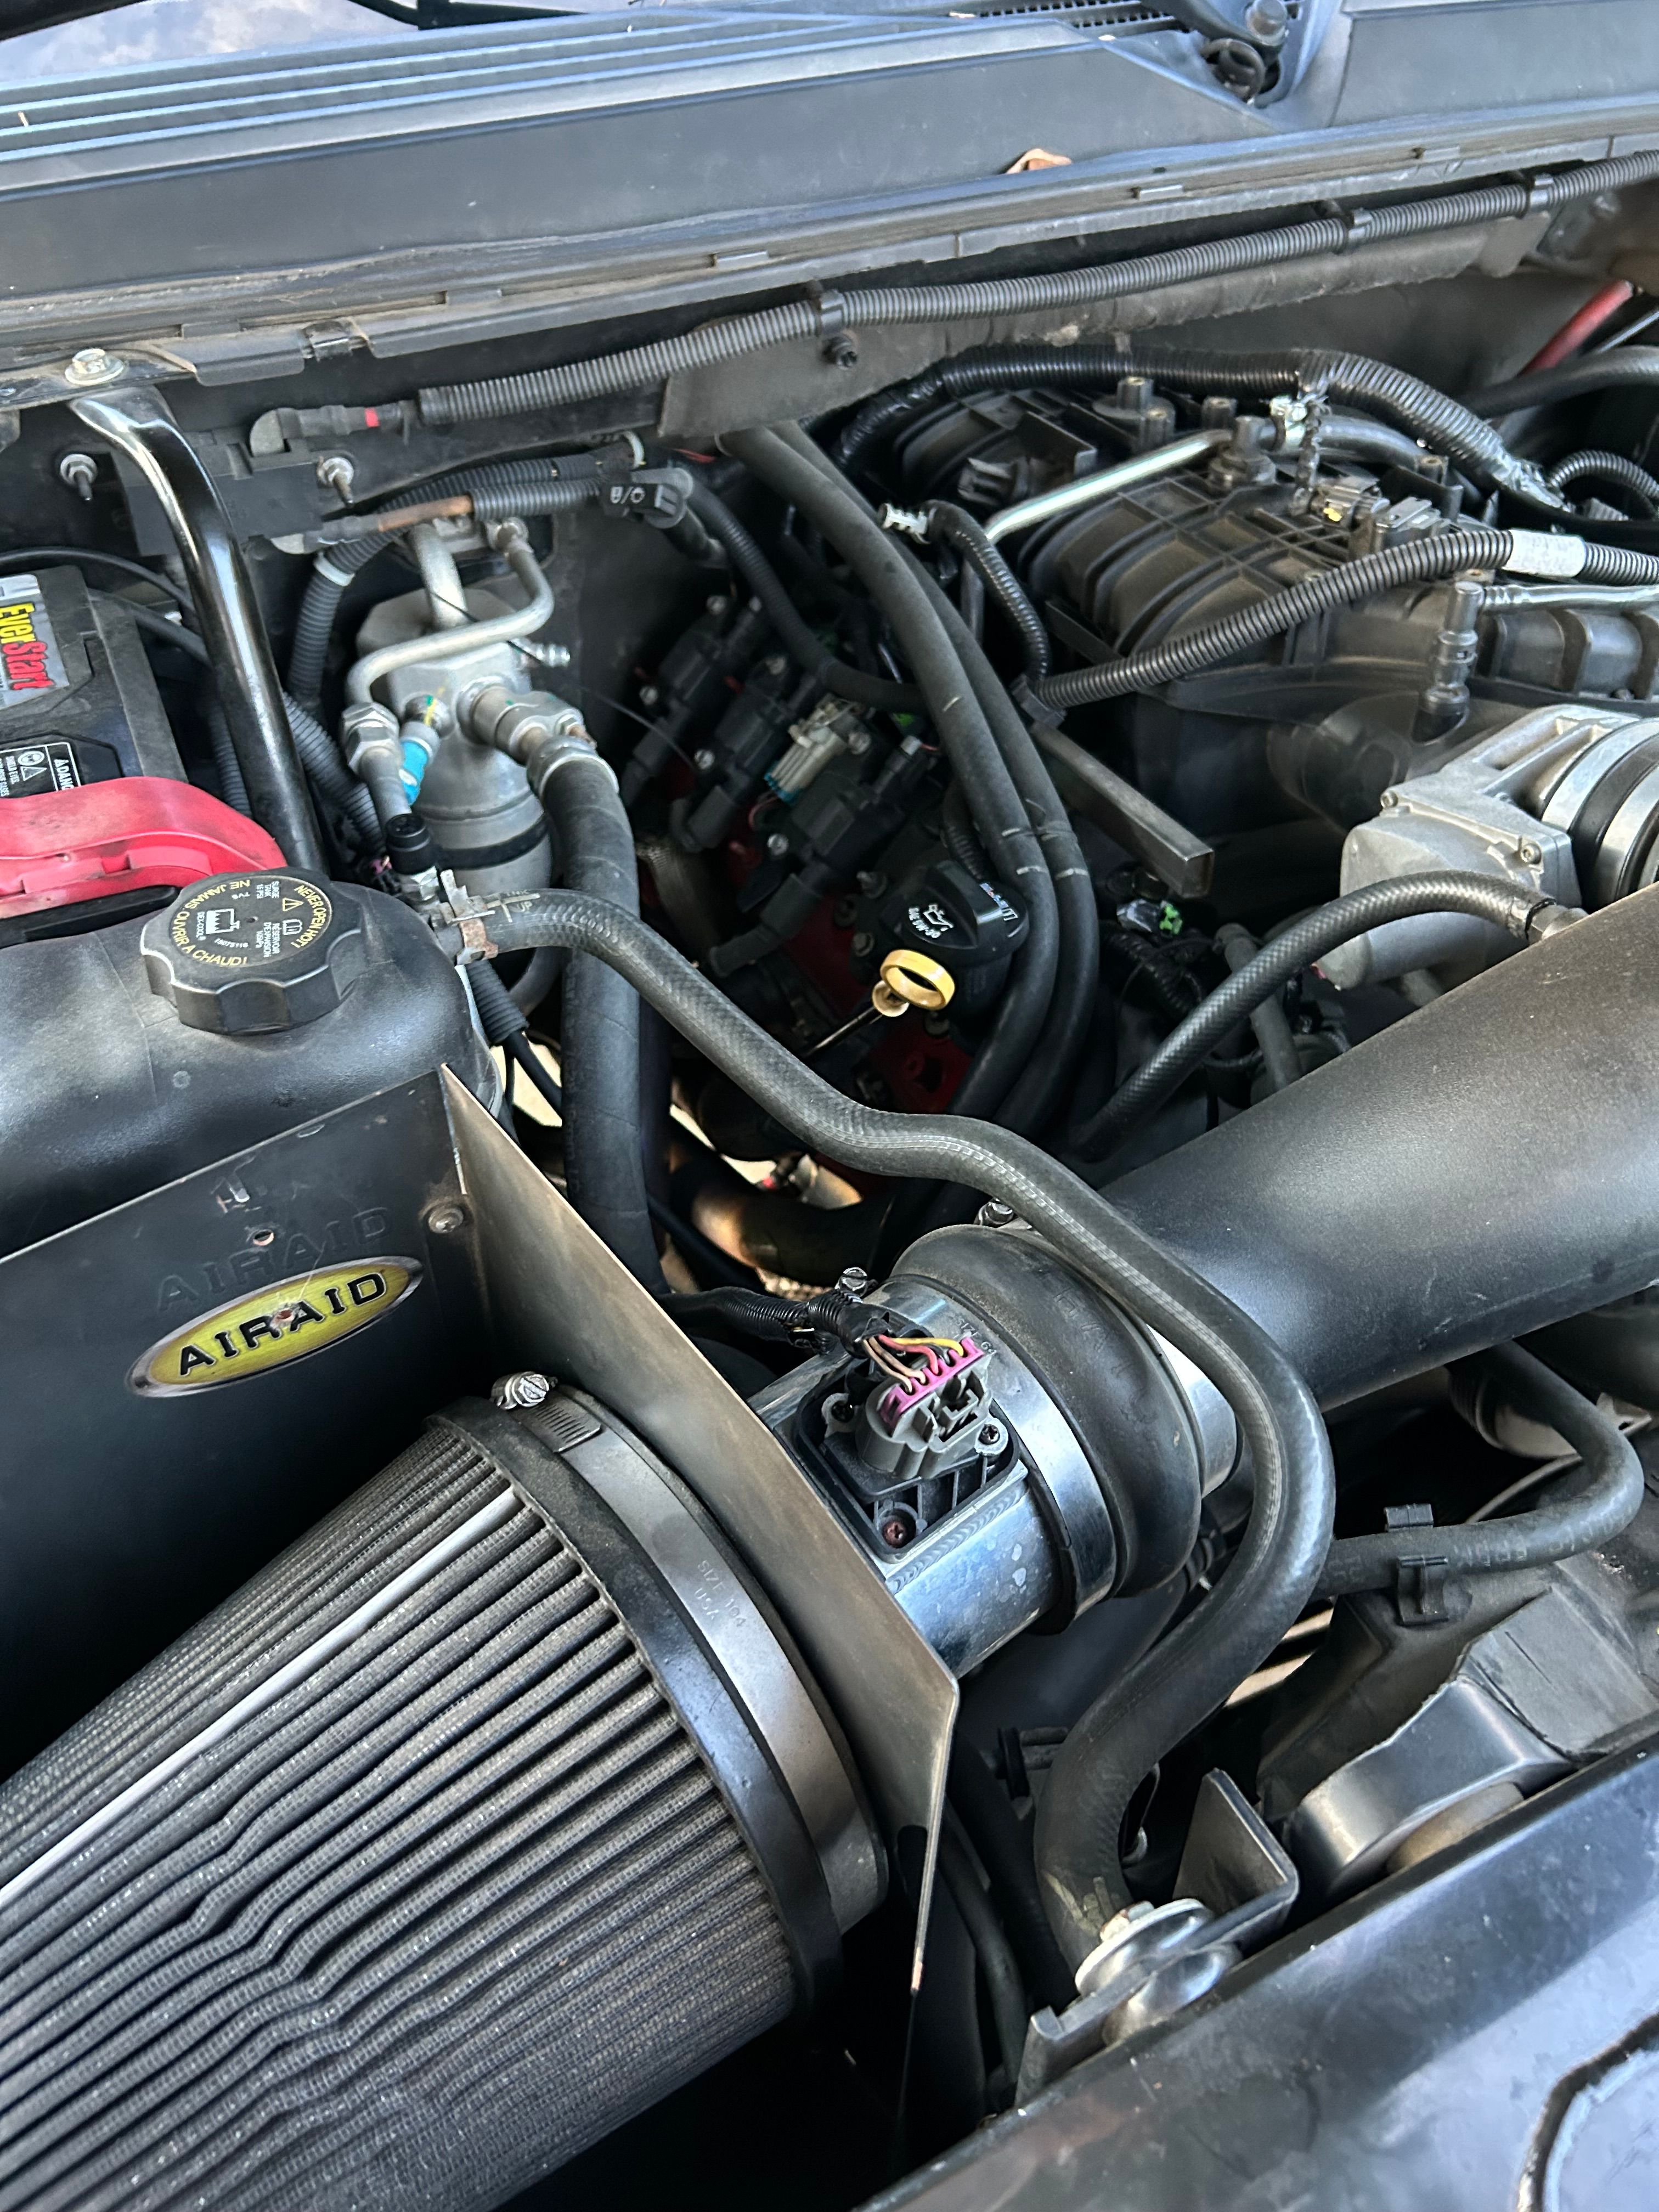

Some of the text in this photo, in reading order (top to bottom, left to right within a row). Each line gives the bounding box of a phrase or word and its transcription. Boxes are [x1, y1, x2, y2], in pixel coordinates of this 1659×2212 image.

[0, 602, 55, 690] EverStart
[56, 765, 75, 790] DANG
[172, 879, 251, 966] NE JAMAIS OUVRIR A CHAUD!
[290, 885, 327, 949] NEVER OPEN HOT!
[157, 1207, 388, 1312] AIRAID
[179, 1272, 387, 1376] AIRAID
